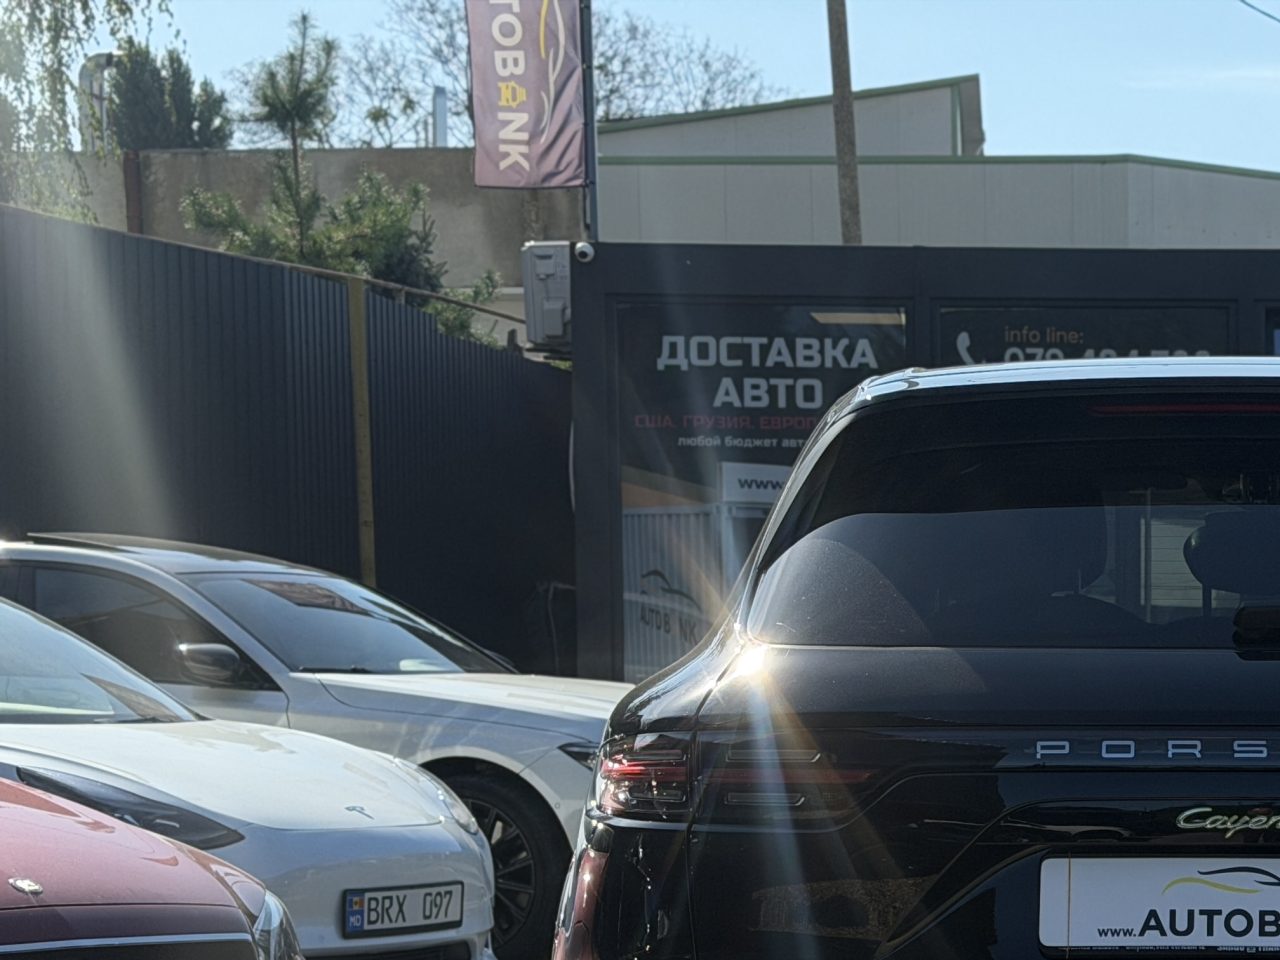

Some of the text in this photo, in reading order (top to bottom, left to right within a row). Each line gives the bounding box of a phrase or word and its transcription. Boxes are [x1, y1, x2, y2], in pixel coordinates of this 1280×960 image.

[488, 0, 530, 172] TOBANK
[1004, 326, 1084, 345] info line:
[656, 335, 879, 371] ДОСТАВКА
[712, 377, 824, 410] АВТО
[759, 416, 817, 430] ЕВРОП
[677, 435, 807, 449] любой бюджет авт
[367, 890, 453, 926] BRX 097
